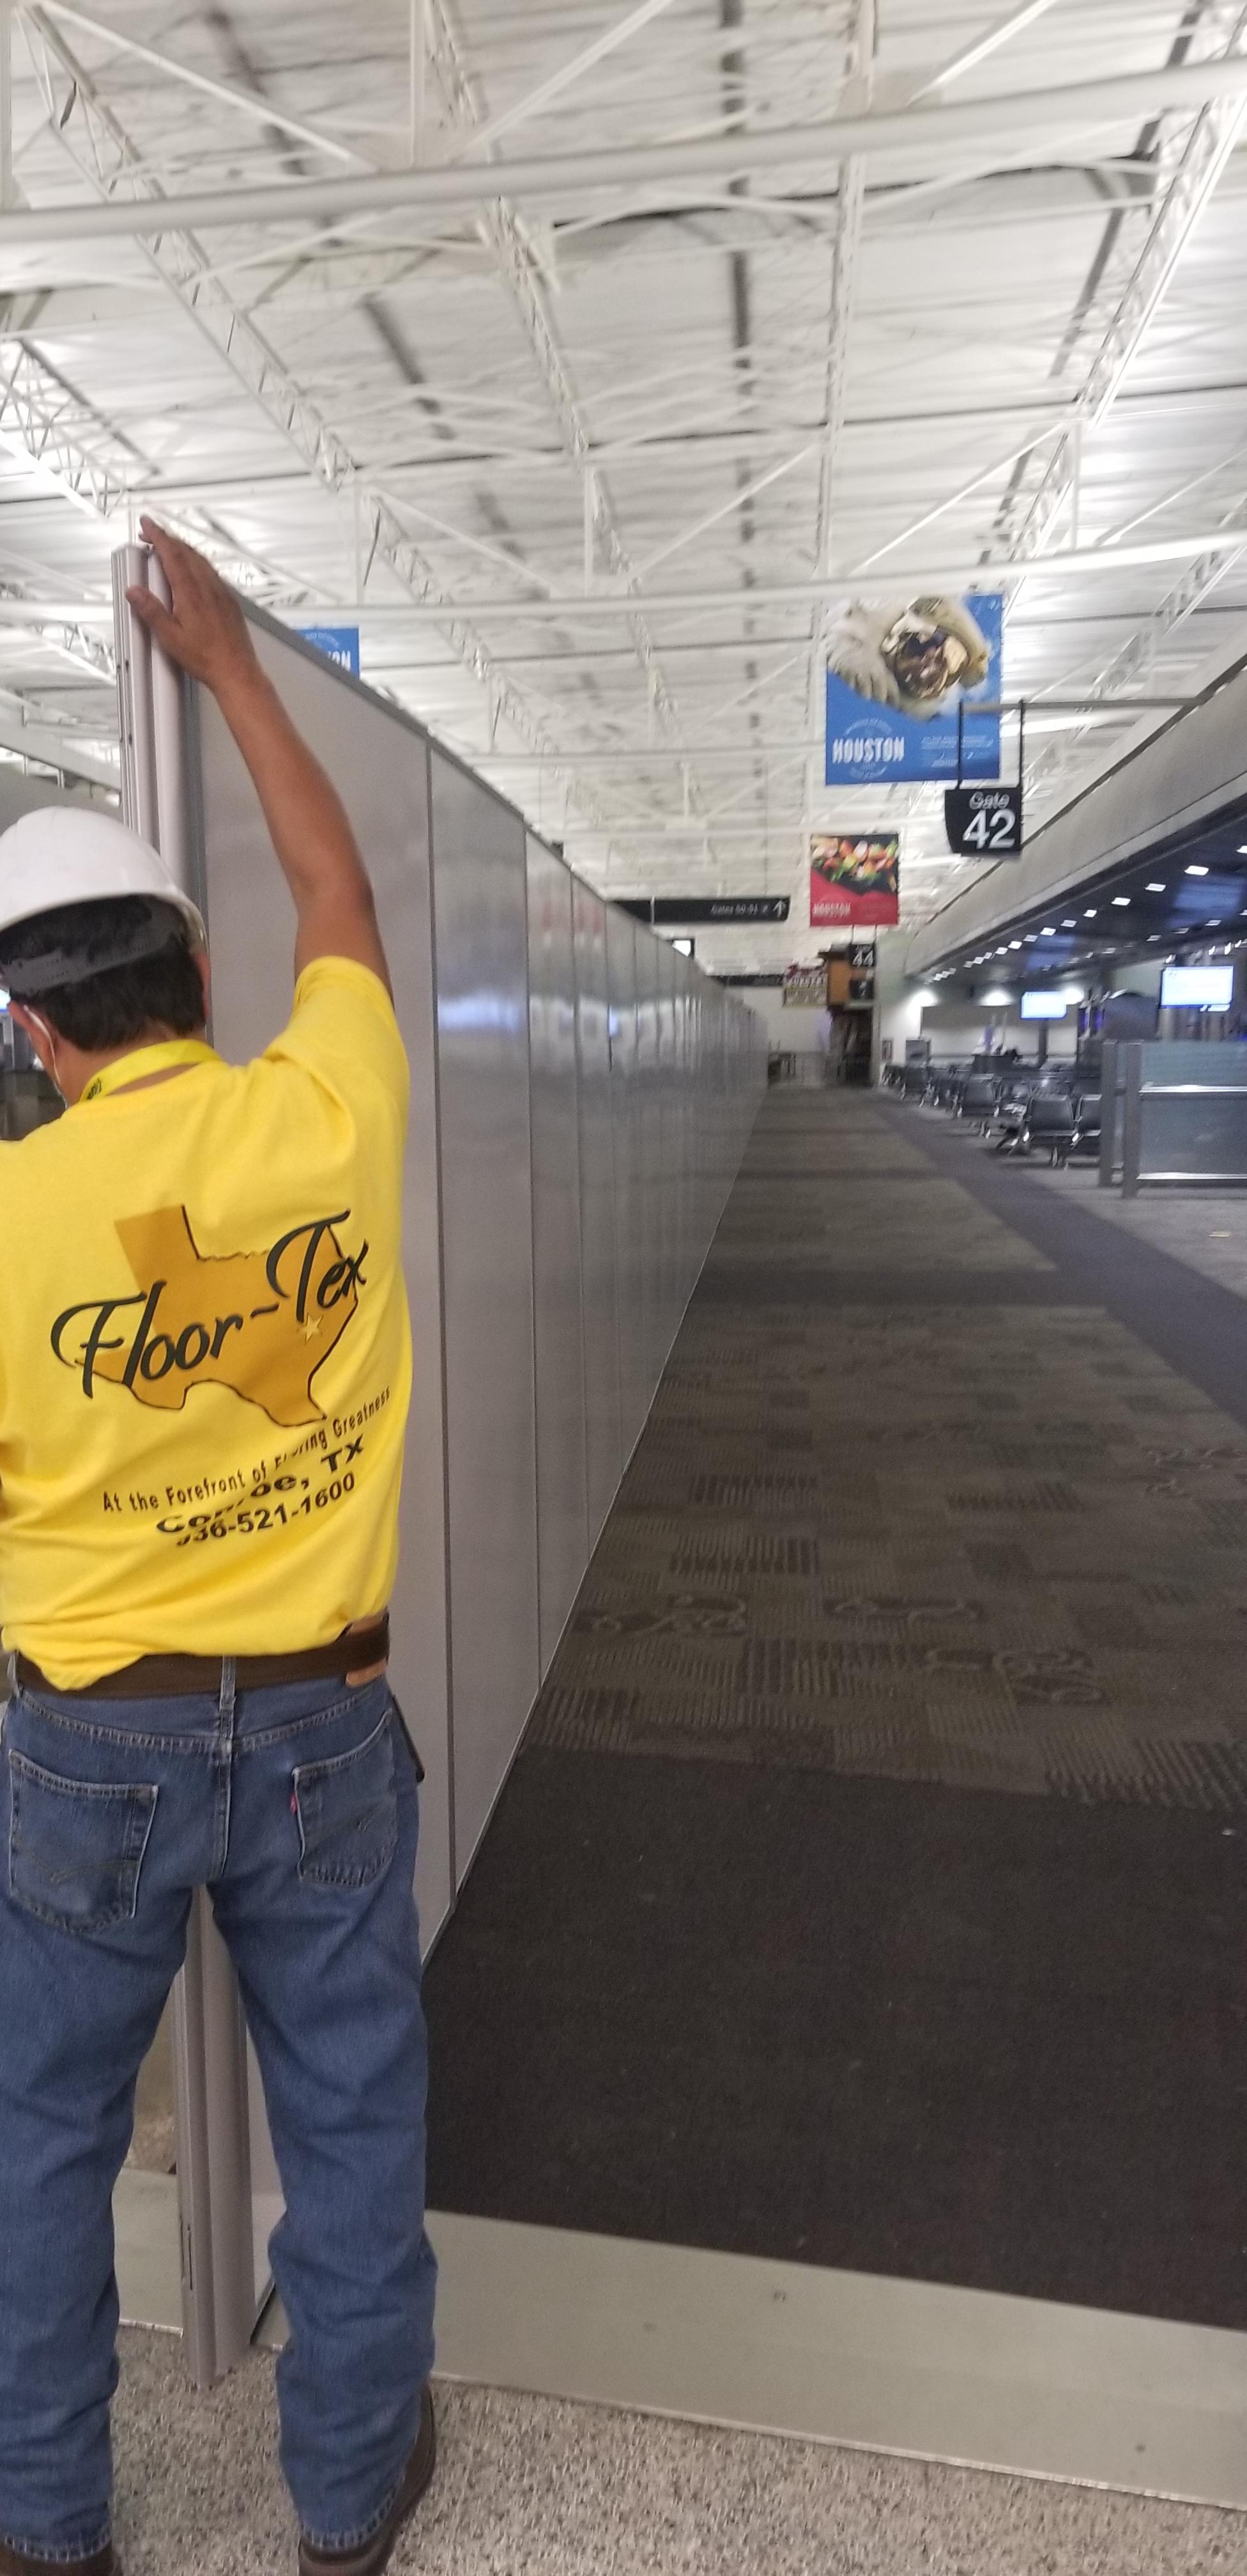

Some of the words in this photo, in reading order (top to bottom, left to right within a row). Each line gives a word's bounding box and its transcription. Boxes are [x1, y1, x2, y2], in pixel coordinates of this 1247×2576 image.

[832, 737, 905, 763] HOUSTON
[969, 792, 1010, 809] Gate
[963, 809, 1016, 849] 42
[813, 903, 851, 917] HOUSTON
[852, 949, 873, 967] 44
[50, 1208, 369, 1399] Floor-Tex
[103, 1491, 122, 1512] At
[129, 1491, 159, 1512] the
[165, 1468, 245, 1506] Forefront
[253, 1459, 266, 1483] of
[332, 1386, 390, 1438] Greatness
[156, 1475, 310, 1533] Cooe,
[321, 1433, 364, 1473] TX
